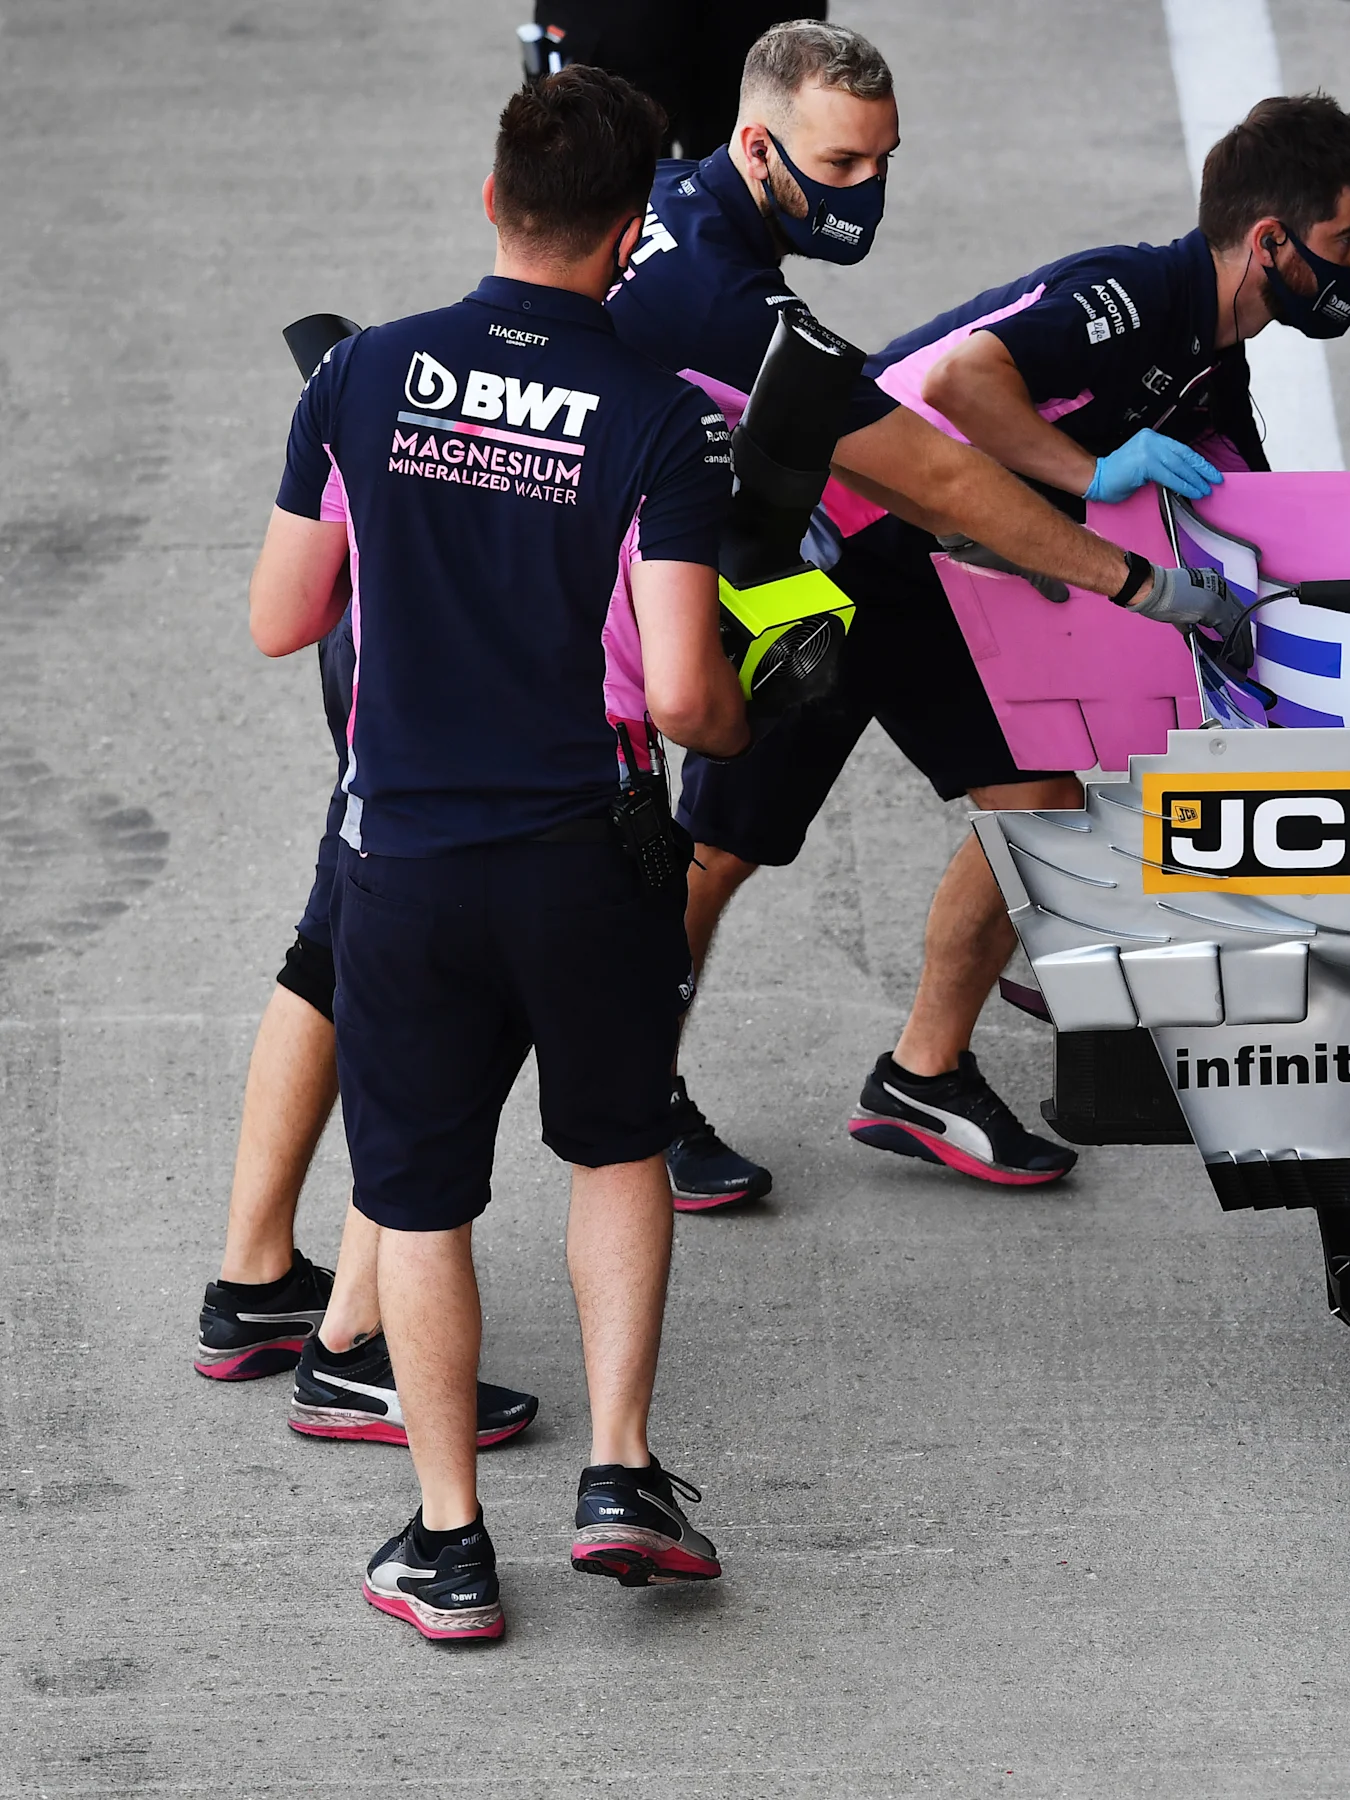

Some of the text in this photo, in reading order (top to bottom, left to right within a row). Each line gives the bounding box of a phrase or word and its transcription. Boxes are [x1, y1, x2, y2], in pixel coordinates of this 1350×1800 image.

[836, 219, 864, 236] BWT
[1072, 292, 1097, 320] canada
[1090, 284, 1126, 335] Acronis
[1106, 278, 1141, 330] BOMBARDIER
[488, 323, 550, 347] HACKETT
[460, 369, 601, 438] BWT
[391, 428, 582, 487] MAGNESIUM
[387, 456, 578, 506] MINERALIZED WATER
[1174, 805, 1199, 823] JCB
[606, 1508, 625, 1516] BWT
[459, 1592, 478, 1602] BWT
